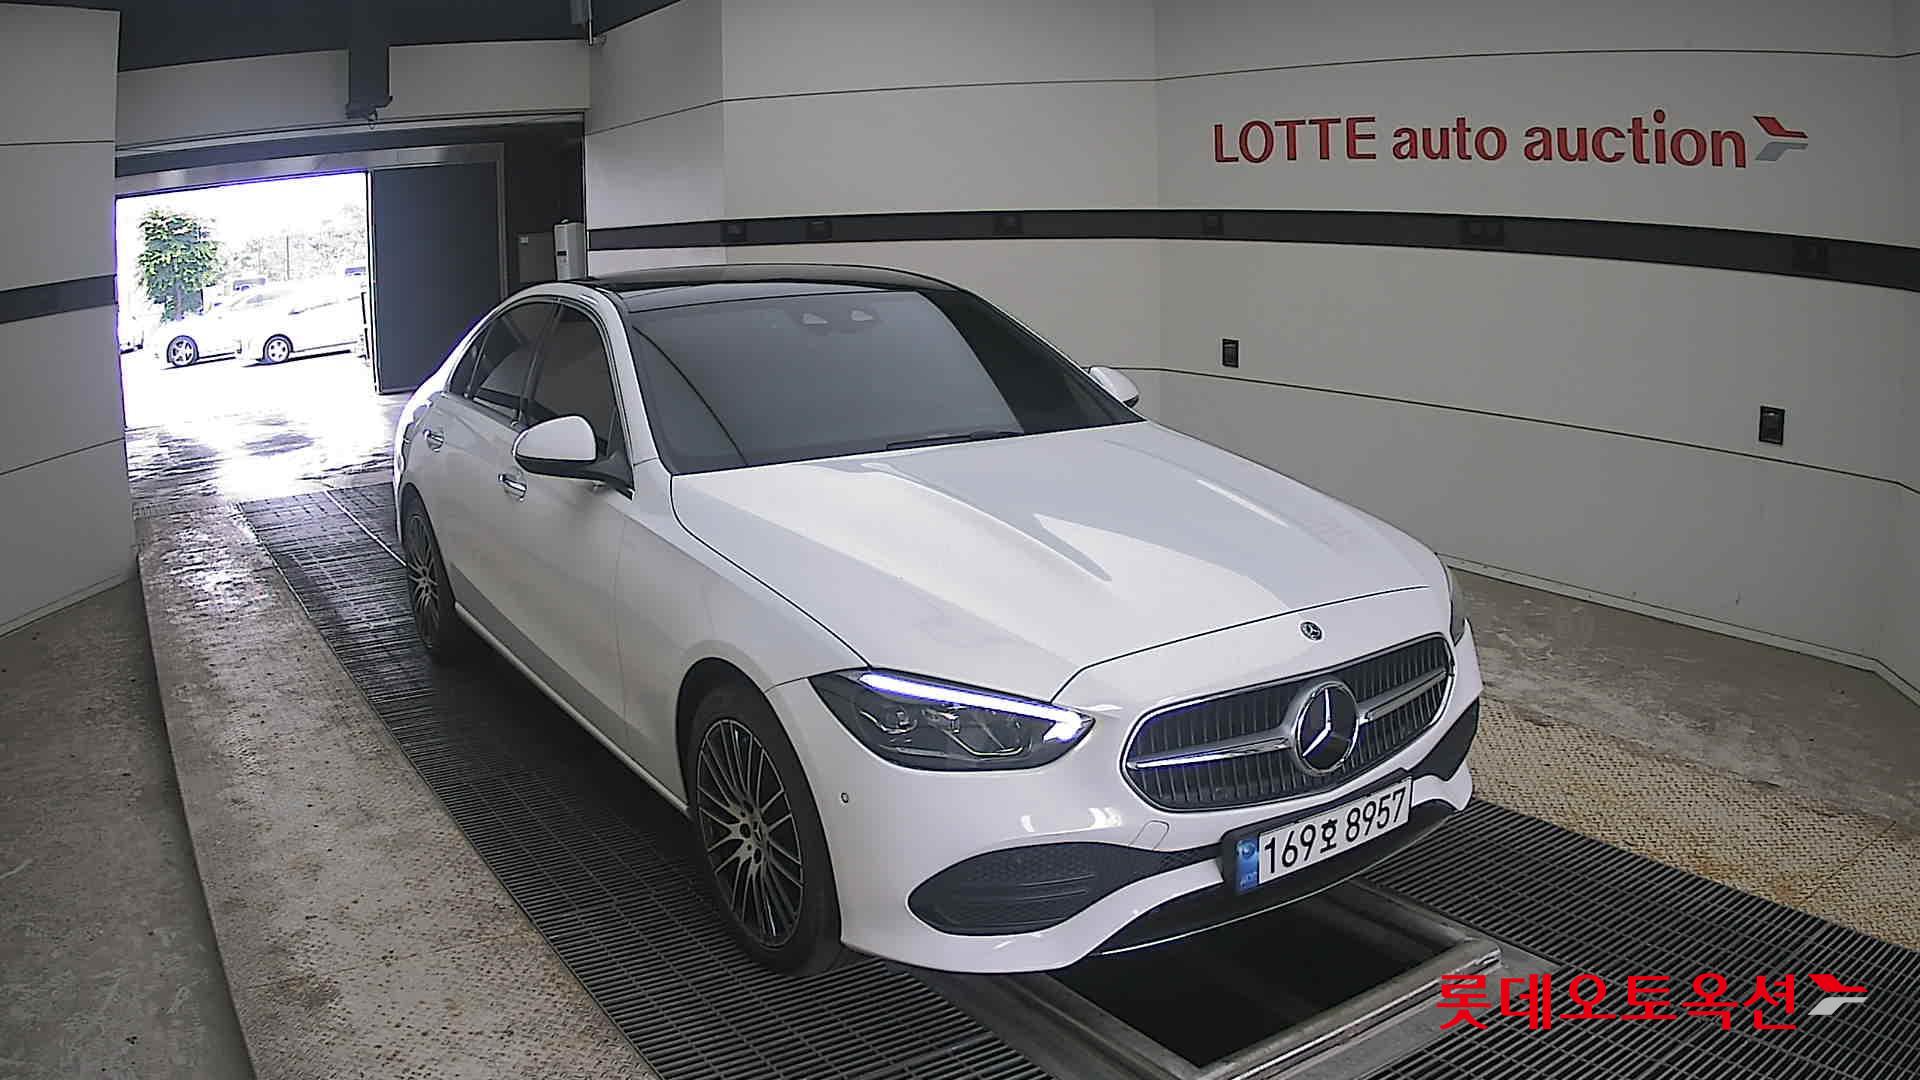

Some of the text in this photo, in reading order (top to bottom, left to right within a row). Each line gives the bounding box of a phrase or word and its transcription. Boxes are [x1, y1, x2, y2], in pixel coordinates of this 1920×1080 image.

[1213, 109, 1747, 168] LOTTE auto auction
[1264, 786, 1407, 874] 169호 8957
